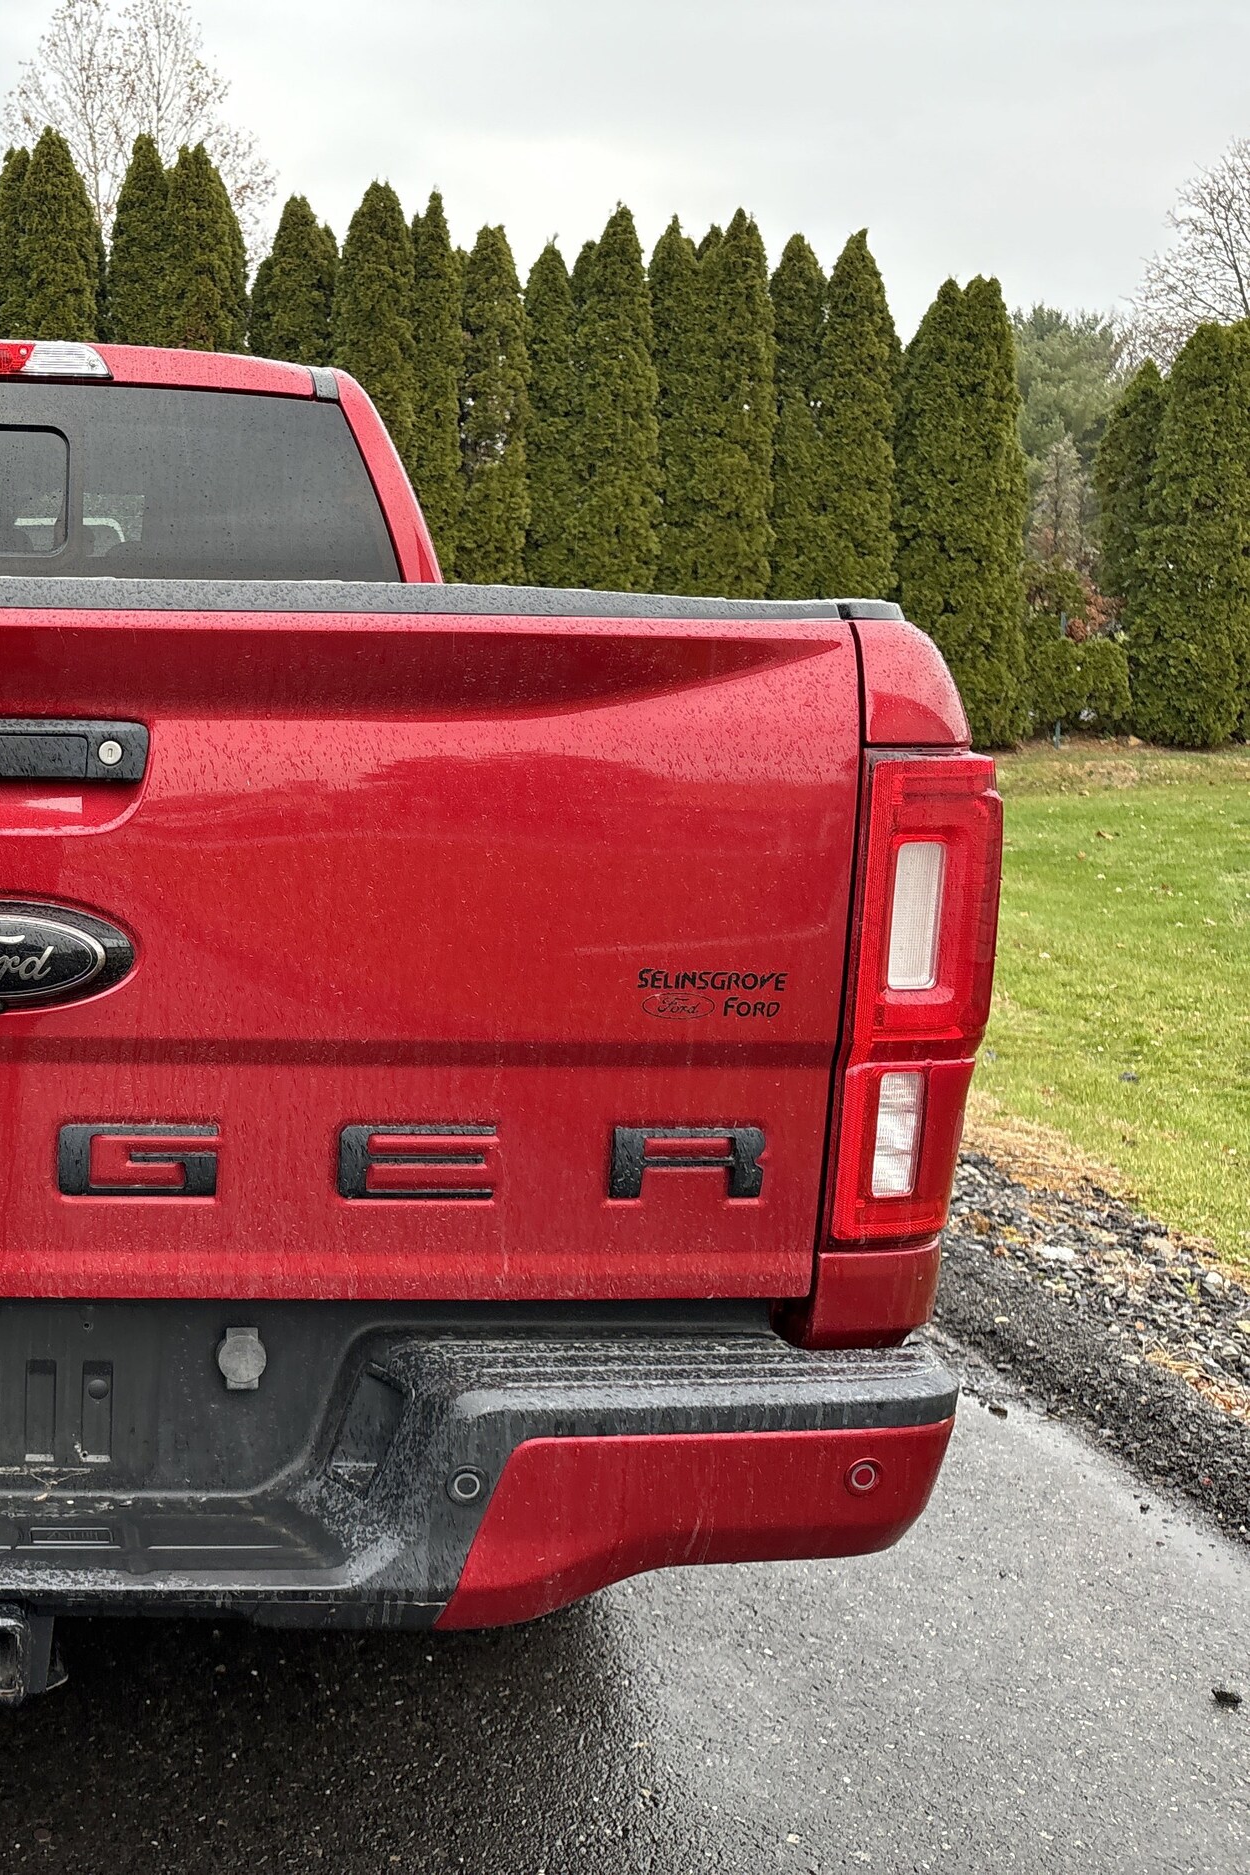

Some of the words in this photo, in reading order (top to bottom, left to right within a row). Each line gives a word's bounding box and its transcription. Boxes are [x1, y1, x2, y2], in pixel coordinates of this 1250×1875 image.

[637, 968, 789, 992] SELINSGROVE
[657, 996, 701, 1015] Ford
[722, 996, 781, 1018] FORD
